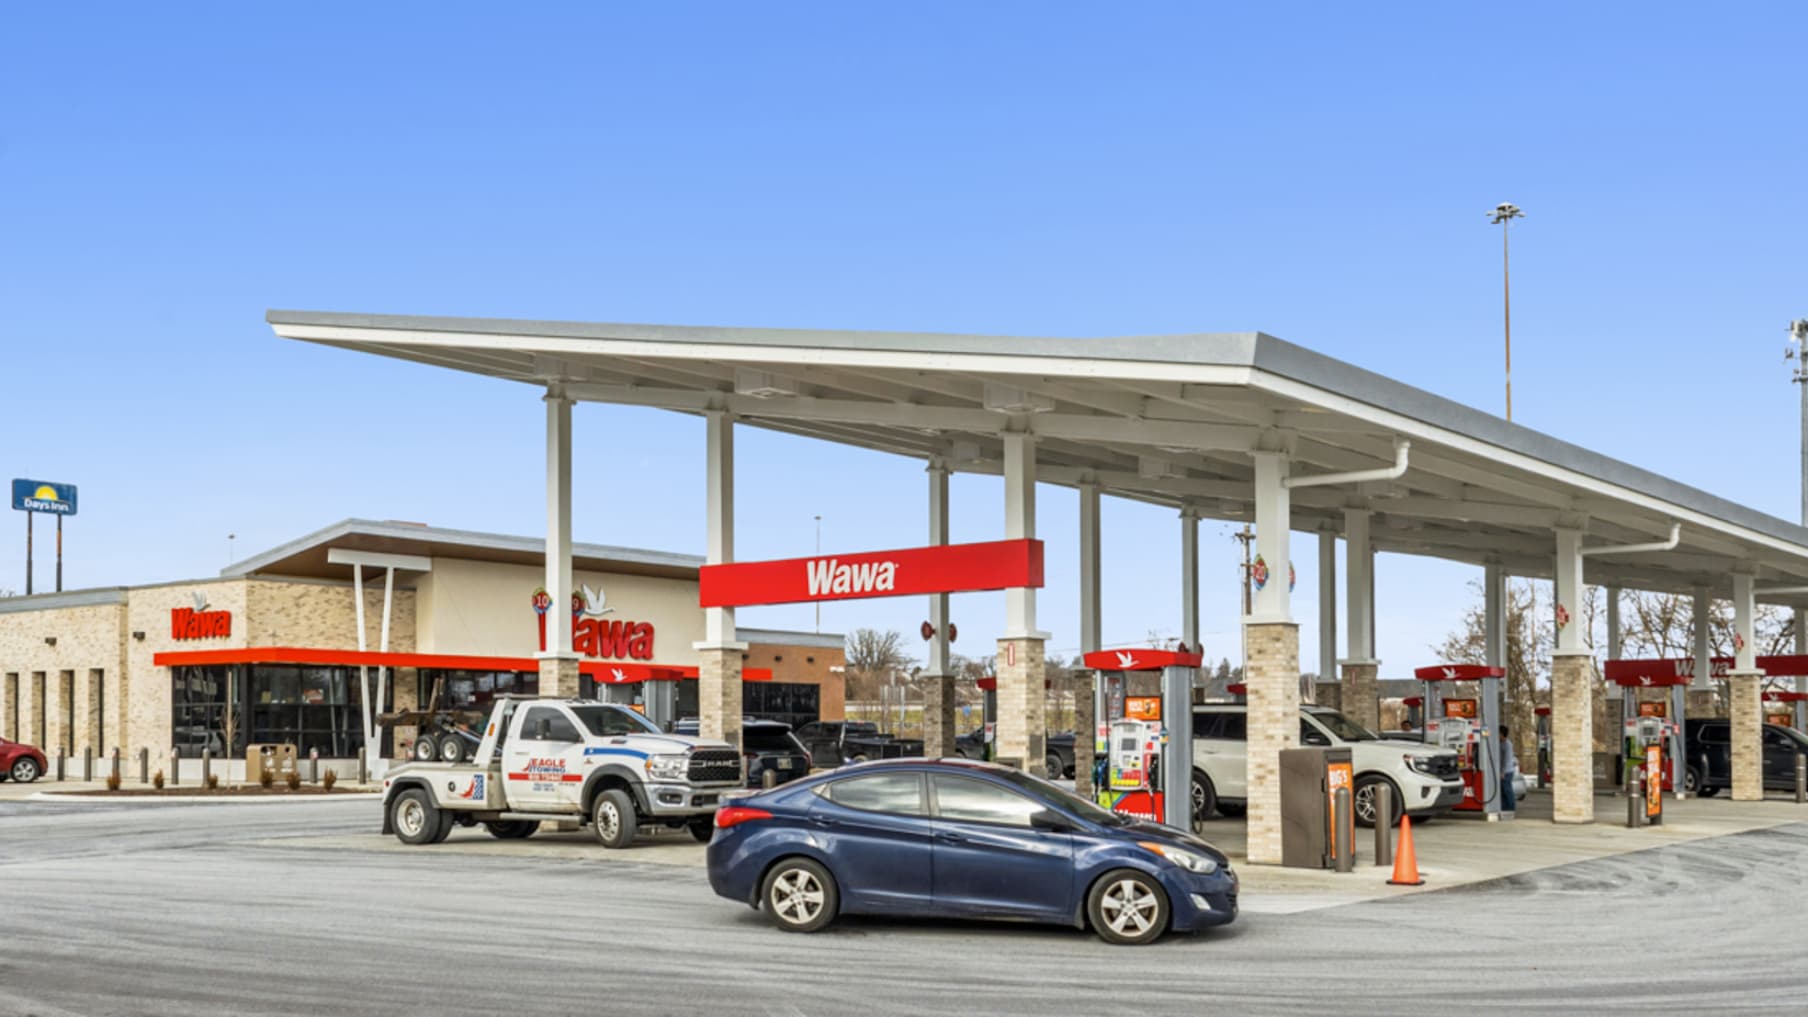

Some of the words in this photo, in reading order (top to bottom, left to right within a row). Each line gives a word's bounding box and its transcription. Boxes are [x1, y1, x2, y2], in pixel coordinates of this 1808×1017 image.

[24, 497, 49, 511] Days
[51, 501, 69, 512] Inn
[807, 559, 895, 596] Wawa
[537, 598, 549, 608] 10
[171, 606, 231, 641] Wawa
[530, 757, 566, 767] EAGLE
[530, 766, 566, 774] TOWING
